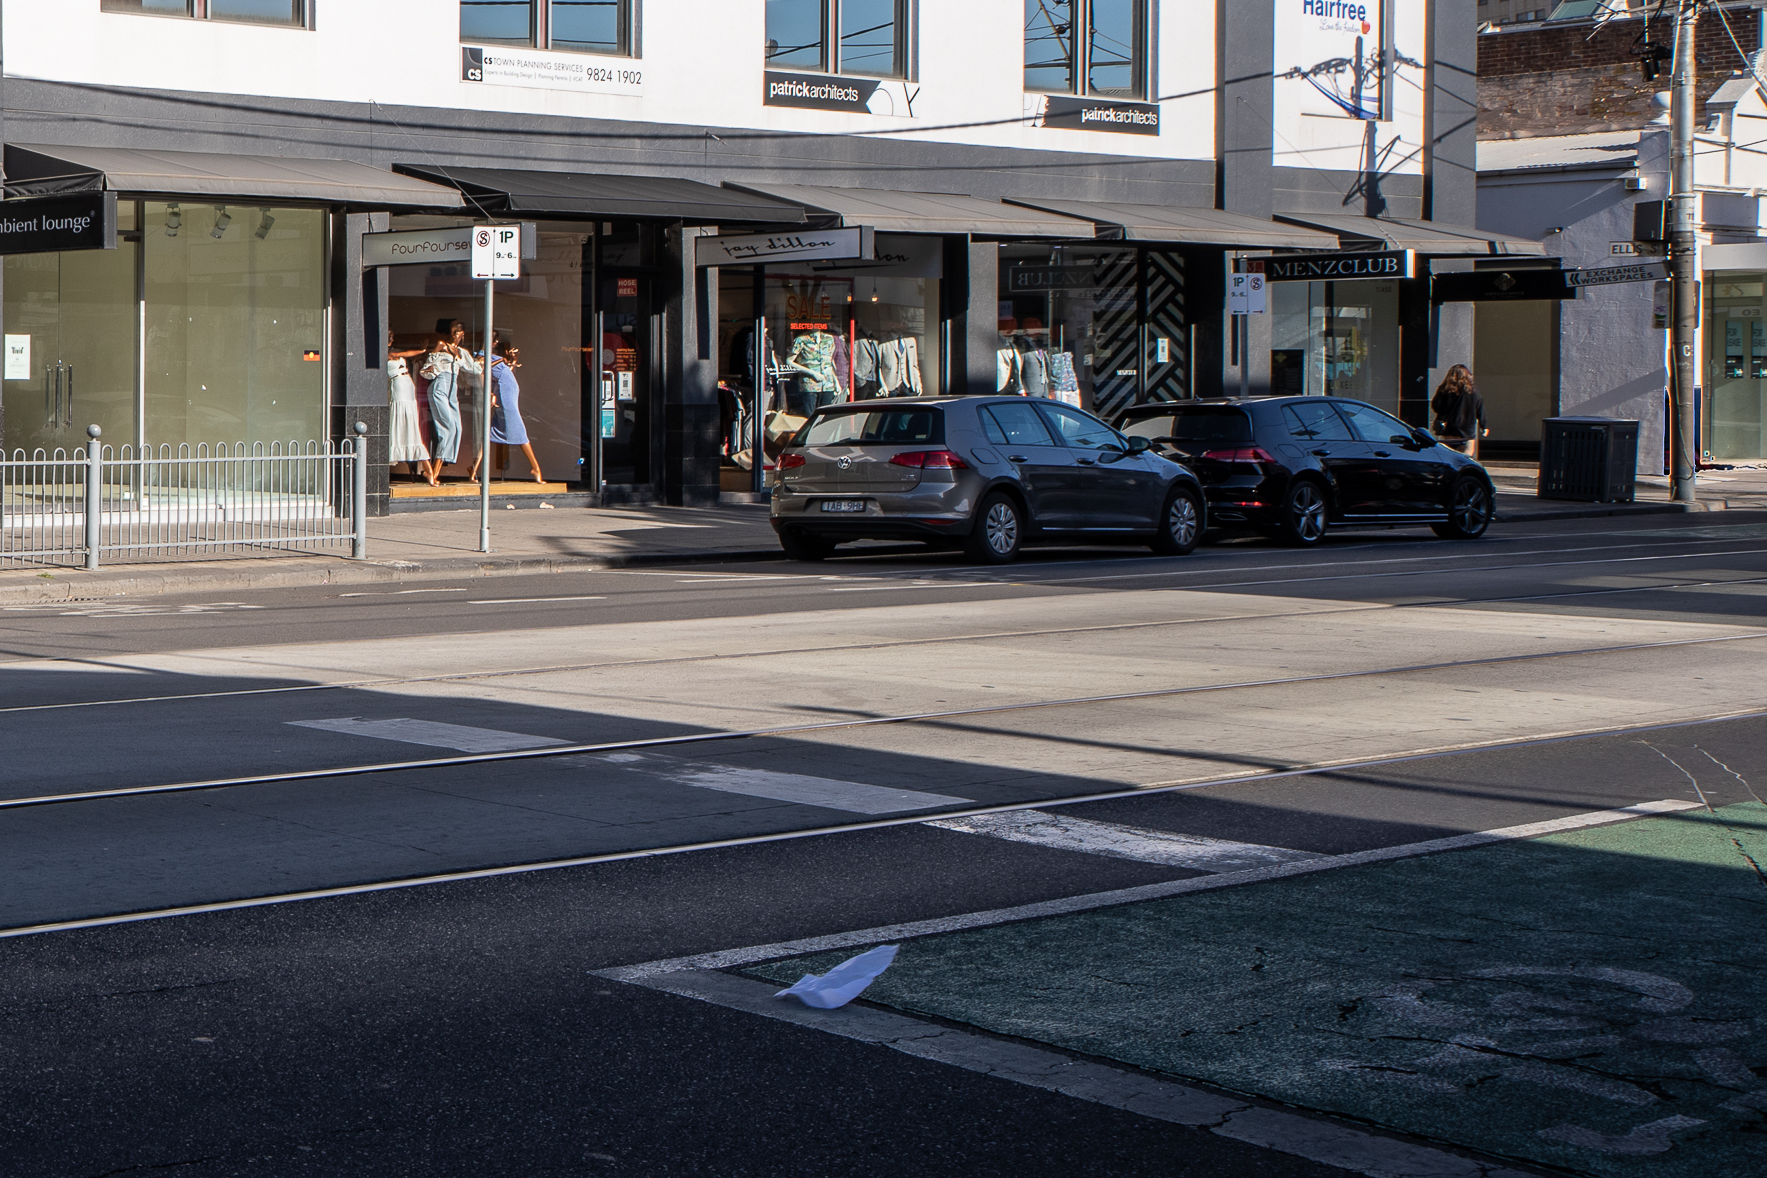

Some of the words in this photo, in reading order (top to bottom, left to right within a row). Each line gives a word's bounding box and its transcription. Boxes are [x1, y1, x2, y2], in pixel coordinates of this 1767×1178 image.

[484, 56, 493, 65] CS
[493, 57, 515, 67] TOWN
[517, 59, 552, 71] PLANNING
[554, 63, 583, 73] SERVICES
[467, 68, 483, 81] CS
[586, 67, 613, 82] 9824
[617, 70, 642, 85] 1902
[770, 80, 859, 102] patrickarchitects
[1081, 107, 1158, 125] patrickarchitects
[499, 230, 514, 243] 1P
[766, 236, 836, 251] dillon
[1611, 244, 1643, 255] ELLIS
[1273, 257, 1398, 277] MENZCLUB
[1585, 266, 1645, 278] EXCHANGE
[1233, 277, 1244, 287] 1P
[1580, 272, 1654, 285] WORKSPACES
[787, 296, 832, 320] SALE
